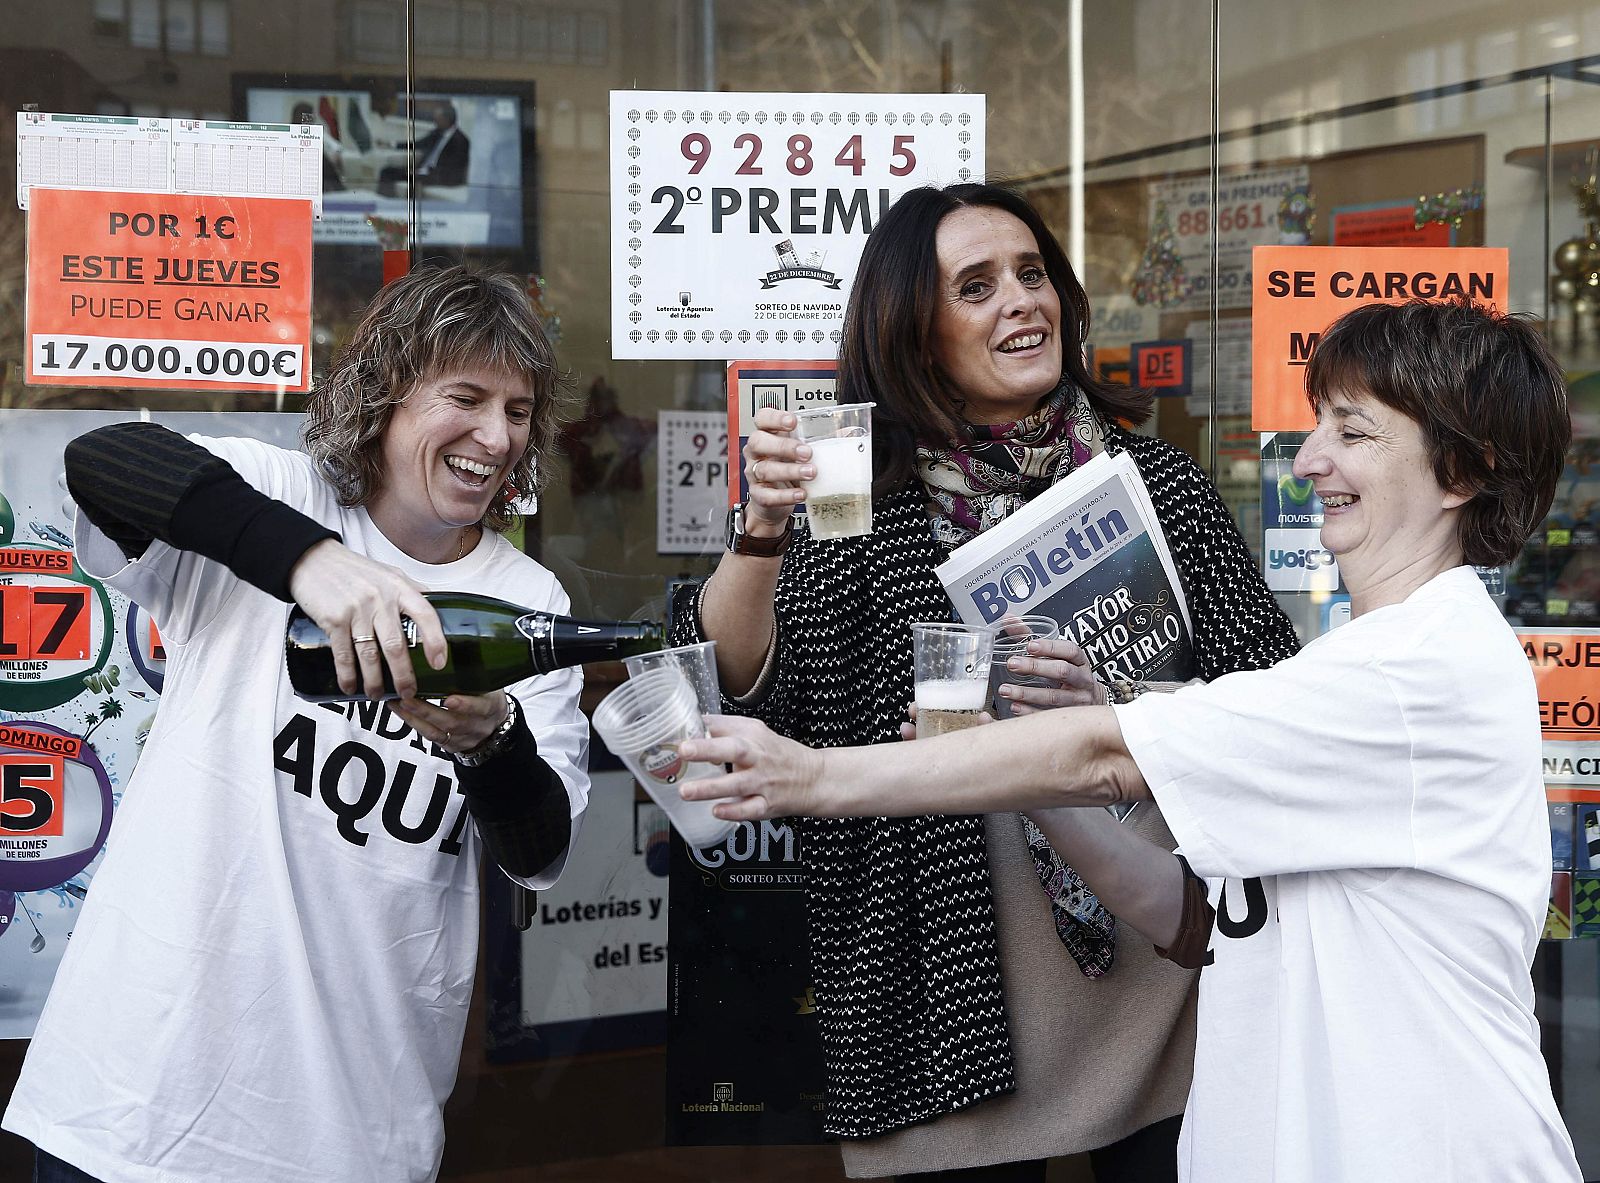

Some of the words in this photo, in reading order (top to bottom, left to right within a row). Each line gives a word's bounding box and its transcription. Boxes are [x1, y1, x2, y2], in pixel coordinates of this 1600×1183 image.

[1188, 190, 1228, 206] GRN
[711, 187, 889, 234] PREMI
[109, 212, 181, 238] POR
[195, 216, 236, 239] 1€
[62, 255, 144, 280] ESTE
[154, 258, 280, 284] JUEVES
[769, 272, 778, 281] 22
[790, 270, 832, 281] DICIEMBRE
[1267, 270, 1316, 298] SE
[1329, 272, 1494, 299] CARGAN
[71, 294, 162, 320] PUEDE
[174, 298, 271, 324] GANAR
[687, 306, 714, 314] Apuestas
[754, 312, 765, 320] 22
[779, 312, 820, 320] DICIEMBRE
[822, 312, 843, 320] 2014
[755, 303, 788, 311] SORTEO
[790, 303, 801, 311] DE
[803, 303, 842, 311] NAVIDAD
[40, 341, 297, 377] 17.000.000€
[1146, 352, 1174, 375] DE
[964, 566, 991, 590] SOCIEDAD
[992, 555, 1014, 572] ESTATAL
[1013, 539, 1038, 558] LOTERÍAS
[1042, 518, 1069, 538] APUESTAS
[1068, 511, 1079, 521] DEL
[1079, 497, 1100, 513] ESTADO
[1100, 491, 1111, 500] S.A.
[0, 552, 68, 568] JUEVES
[1058, 586, 1135, 646] MAYOR
[1135, 615, 1147, 625] ES
[1082, 624, 1129, 668] MIO
[1523, 641, 1600, 668] ARJE
[0, 660, 49, 671] MILLONES
[1152, 650, 1174, 670] NAVIDAD
[6, 672, 16, 680] DE
[18, 672, 41, 680] EUROS
[83, 664, 121, 695] VIP
[1538, 696, 1600, 727] EFÓ
[0, 728, 77, 754] OMINGO
[1542, 758, 1600, 776] NACI
[0, 764, 54, 830] 5
[1553, 806, 1567, 816] 6€
[0, 840, 48, 850] MILLONES
[6, 851, 16, 859] DE
[17, 850, 40, 859] EUROS
[729, 874, 774, 884] SORTEO
[541, 896, 641, 925] Loterías
[649, 898, 662, 920] y
[594, 944, 631, 969] del
[682, 1102, 718, 1112] Lotería
[720, 1102, 764, 1112] Nacional
